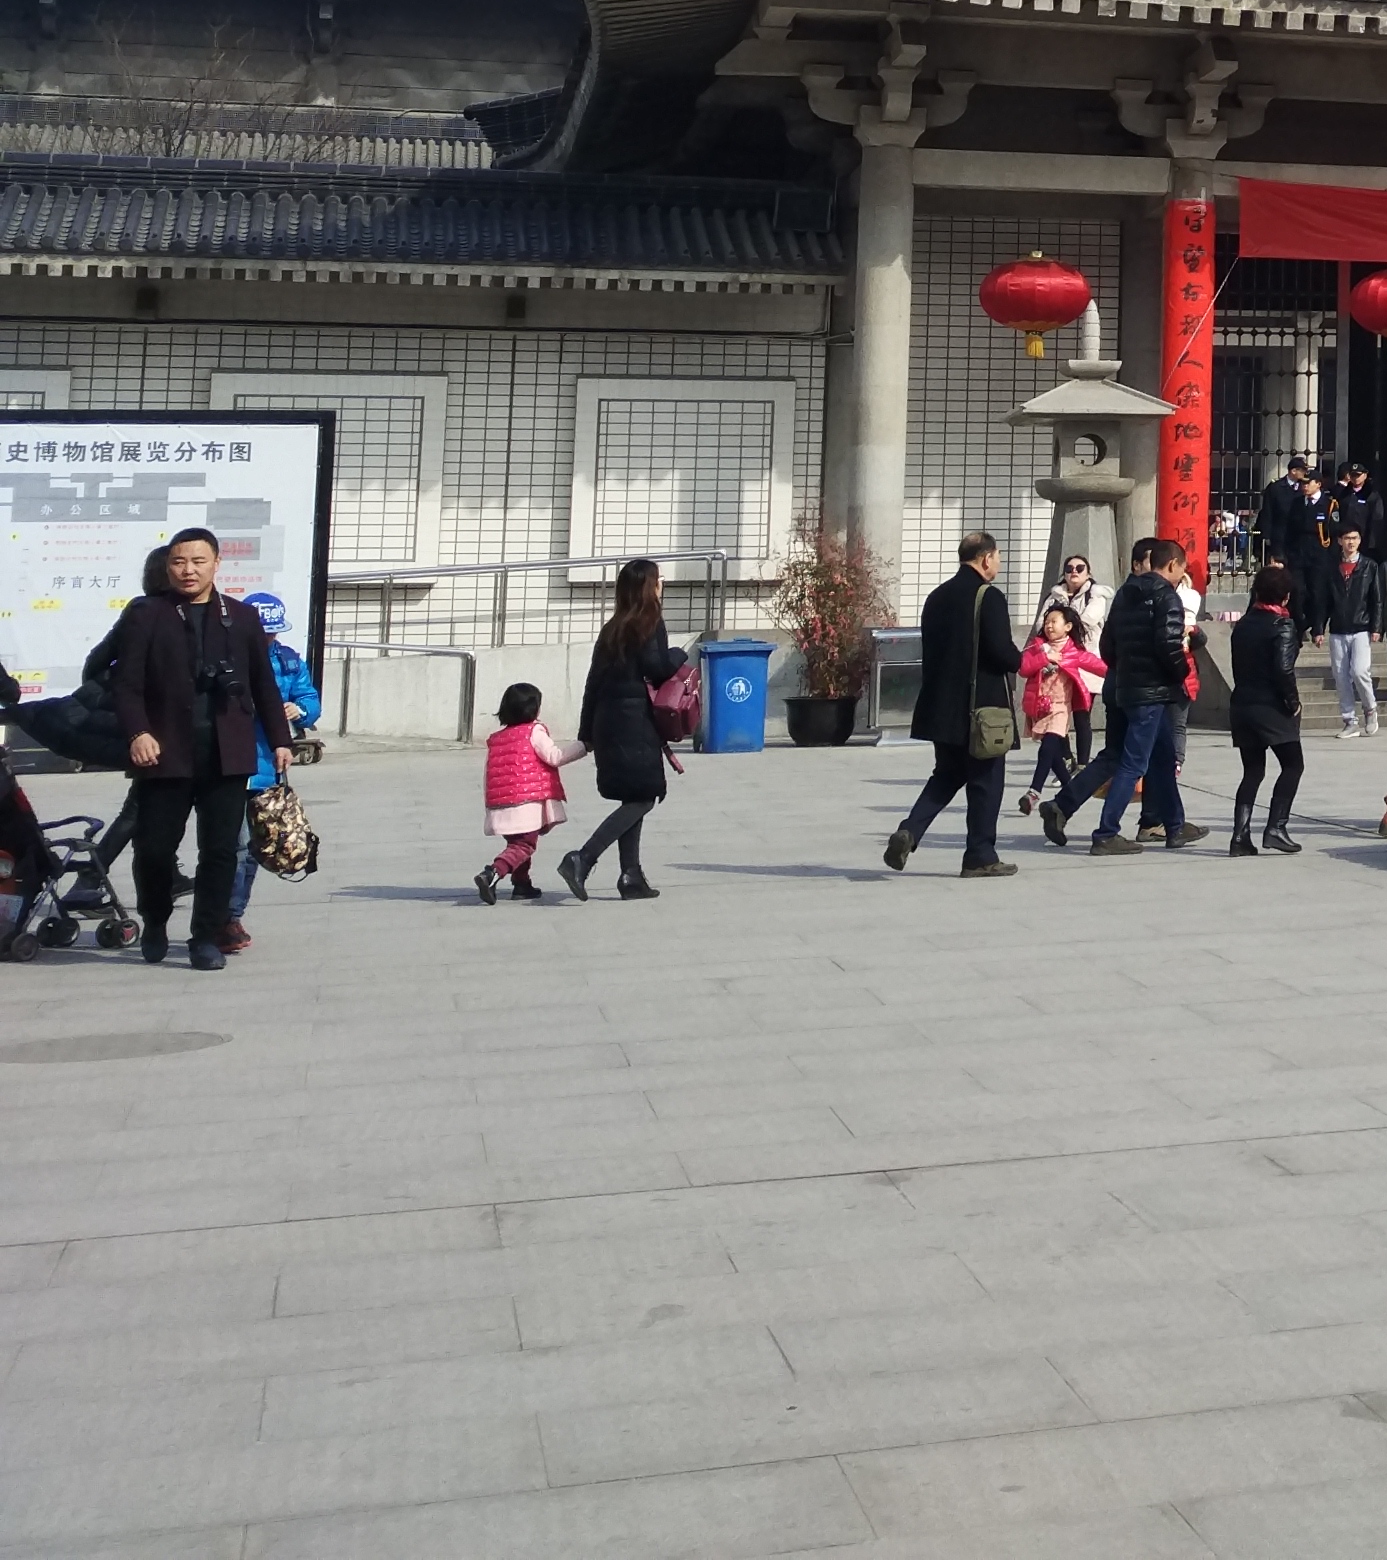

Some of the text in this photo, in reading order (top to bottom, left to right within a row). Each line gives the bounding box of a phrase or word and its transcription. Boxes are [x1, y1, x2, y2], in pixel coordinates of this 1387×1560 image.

[0, 440, 252, 463] 史博物馆展览分布图
[40, 503, 140, 516] 办公区域
[51, 575, 121, 589] 序言大厅
